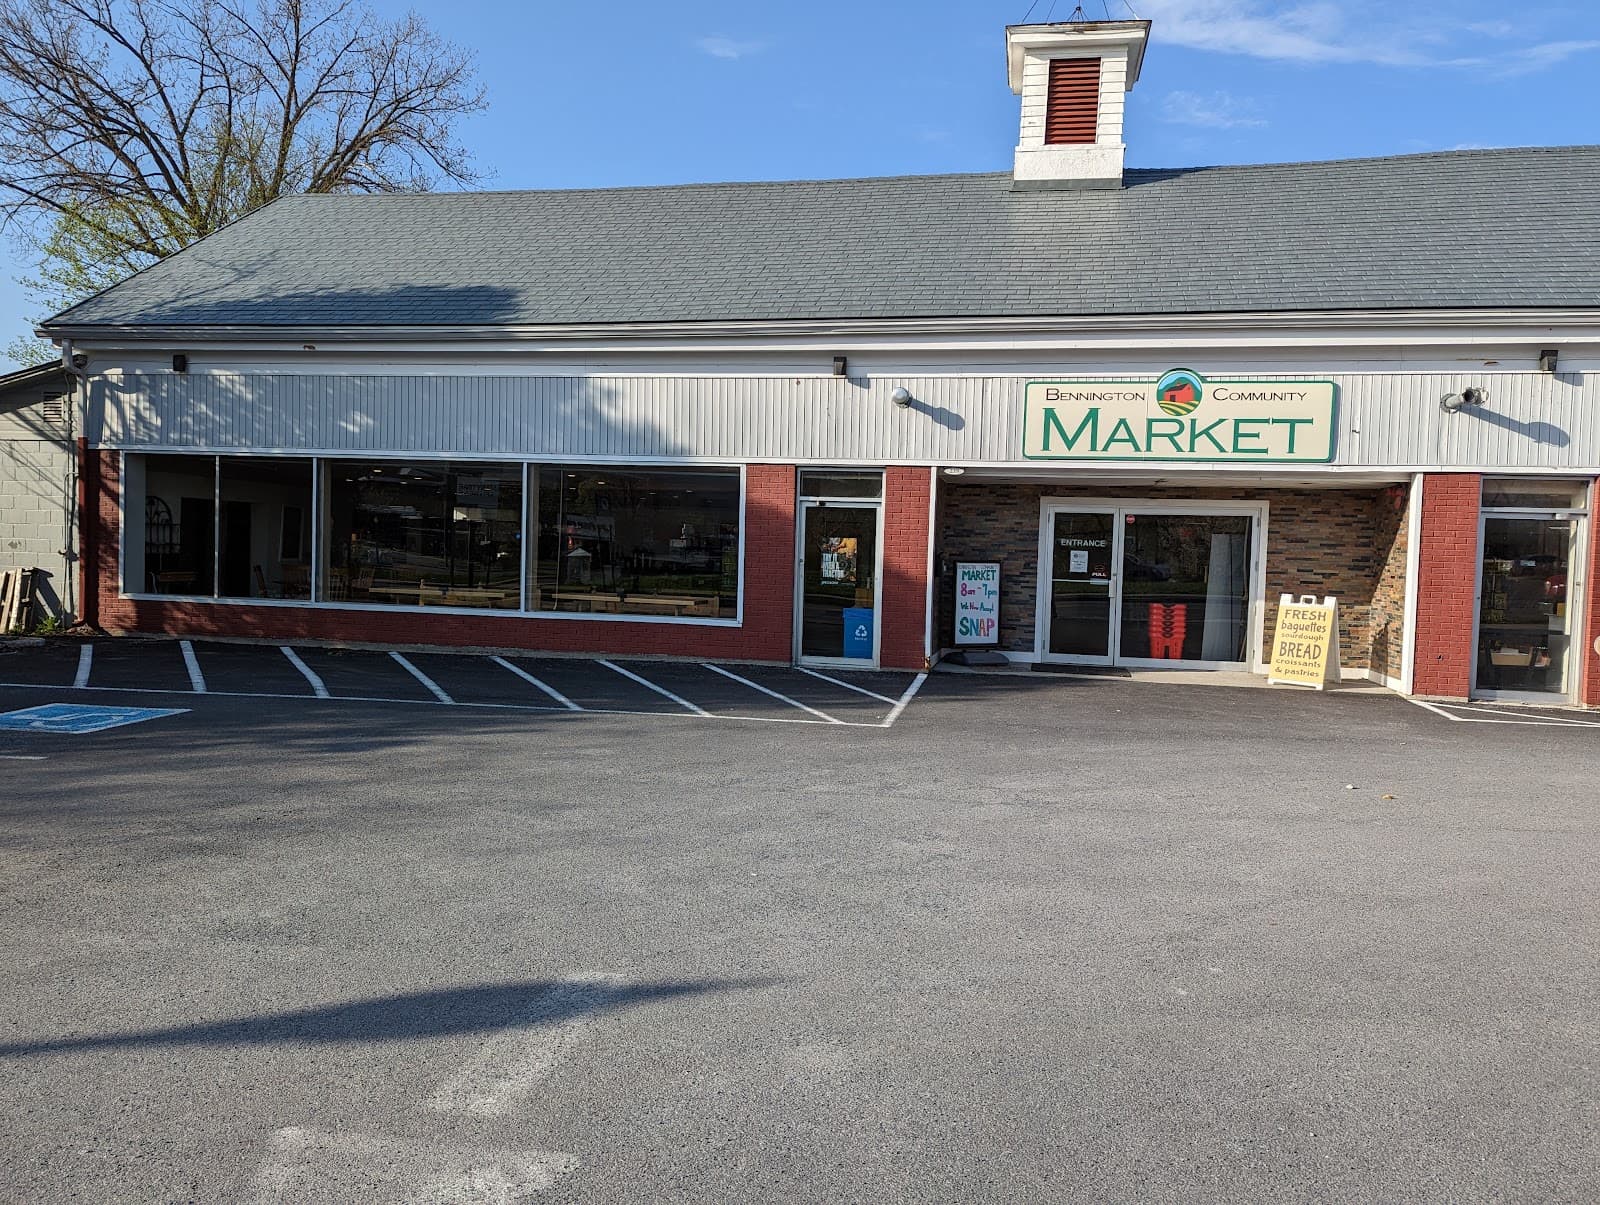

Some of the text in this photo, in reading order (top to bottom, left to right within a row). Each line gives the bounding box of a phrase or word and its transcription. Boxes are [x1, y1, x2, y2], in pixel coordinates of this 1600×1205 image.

[1045, 387, 1307, 402] BENNINGTON COMMUNITY
[1040, 407, 1314, 455] MARKET
[1060, 538, 1107, 548] ENTRANCE
[961, 569, 997, 581] MARKET
[1284, 609, 1327, 621] FRESH
[959, 616, 995, 637] SNAP
[1281, 619, 1327, 633] baguettes
[1281, 632, 1324, 642] sourdough
[1279, 641, 1322, 660] BREAD
[1276, 658, 1321, 668] croissants
[1284, 668, 1320, 677] pastries
